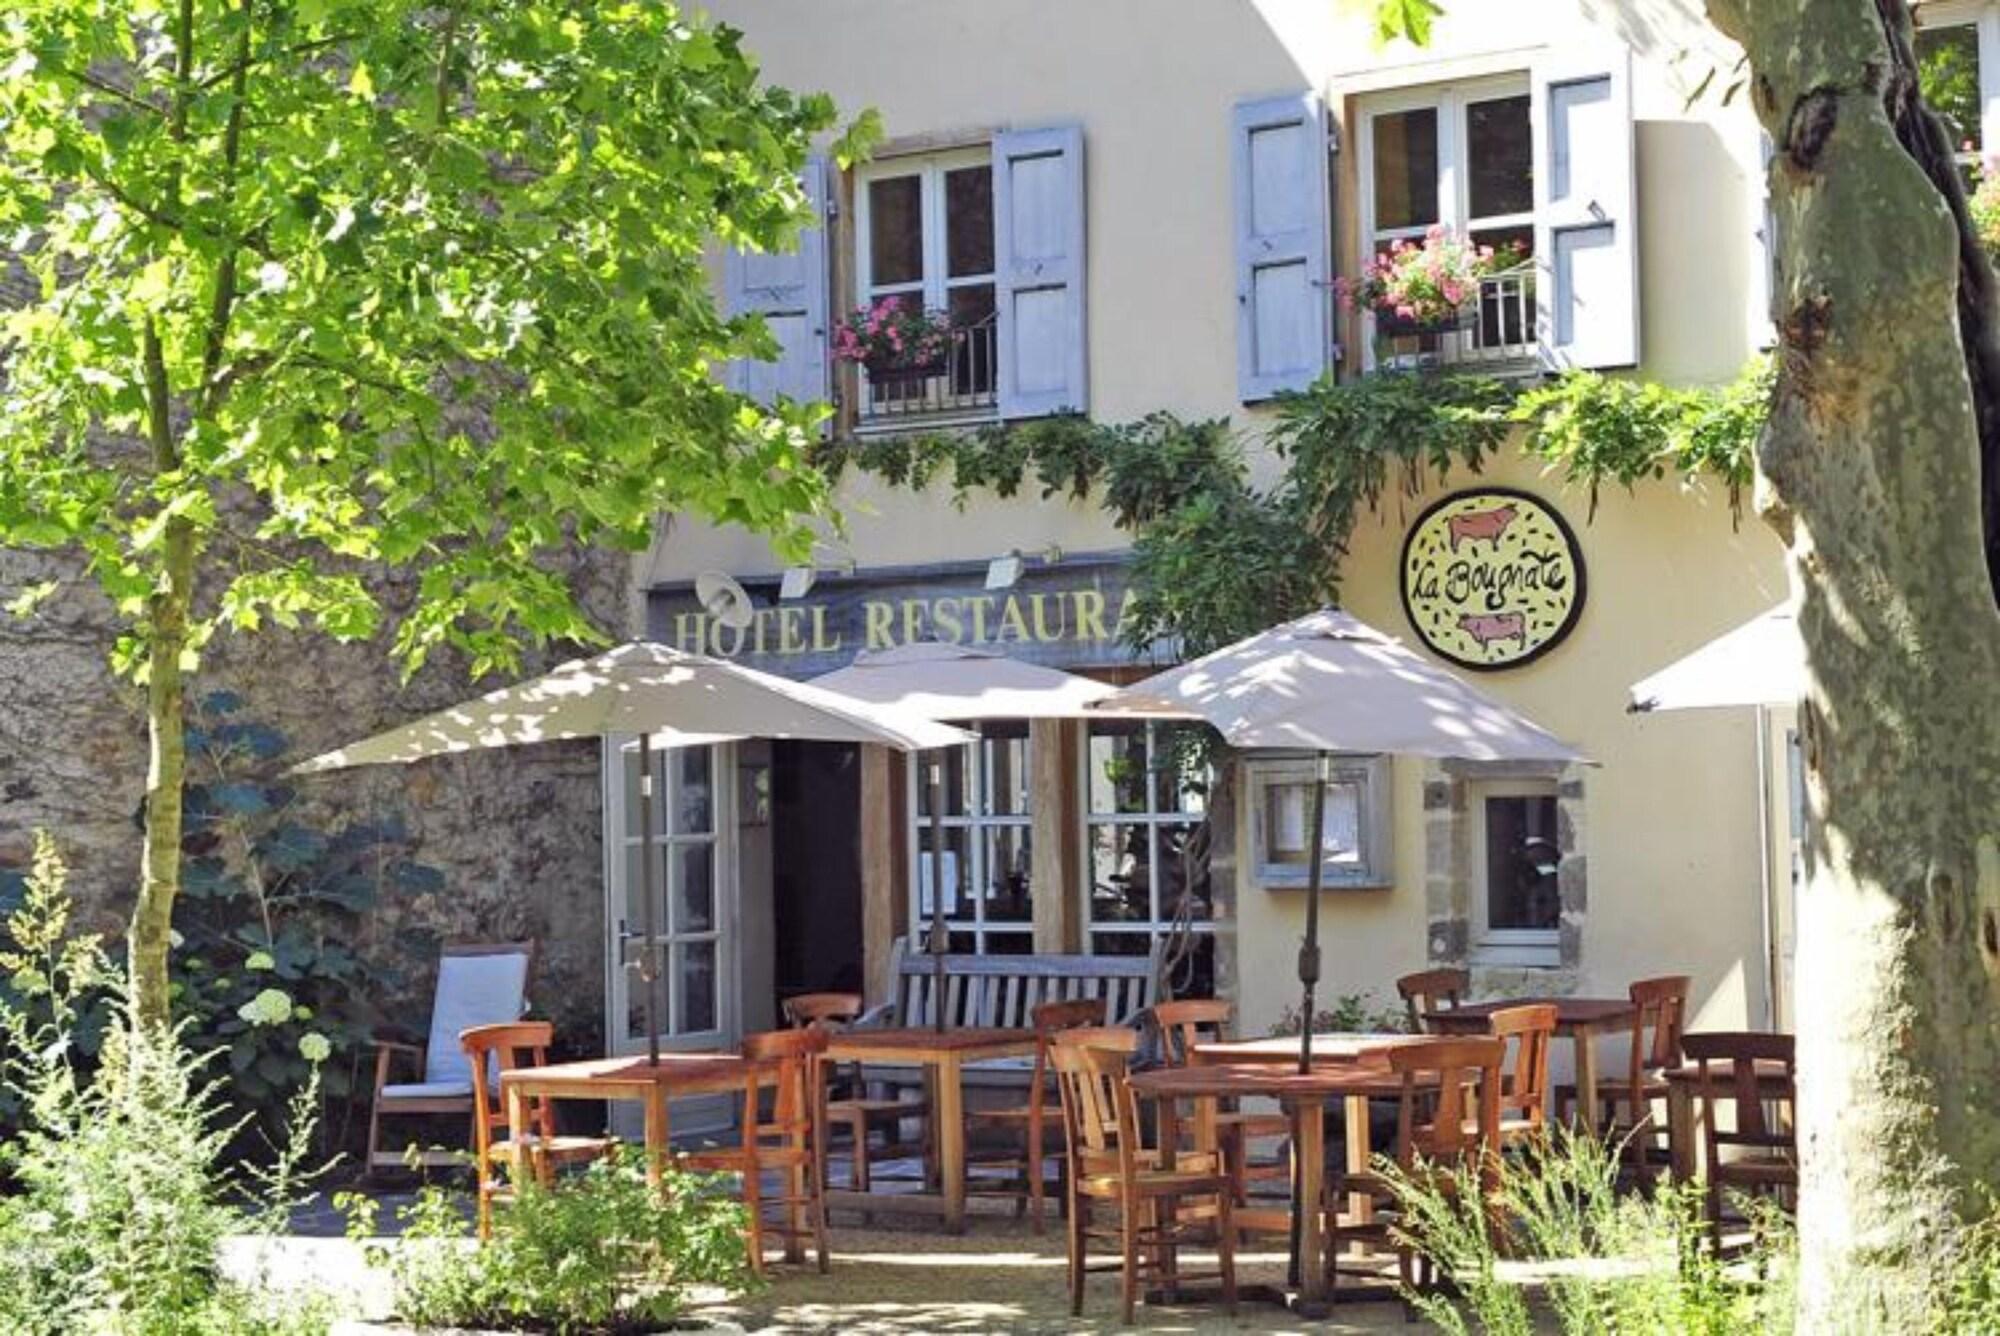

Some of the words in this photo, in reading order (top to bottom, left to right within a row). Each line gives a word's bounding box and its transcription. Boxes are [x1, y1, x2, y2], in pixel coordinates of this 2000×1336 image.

[1411, 560, 1440, 600] La
[1445, 549, 1567, 611] Bougnate
[864, 588, 1142, 653] RESTAURA
